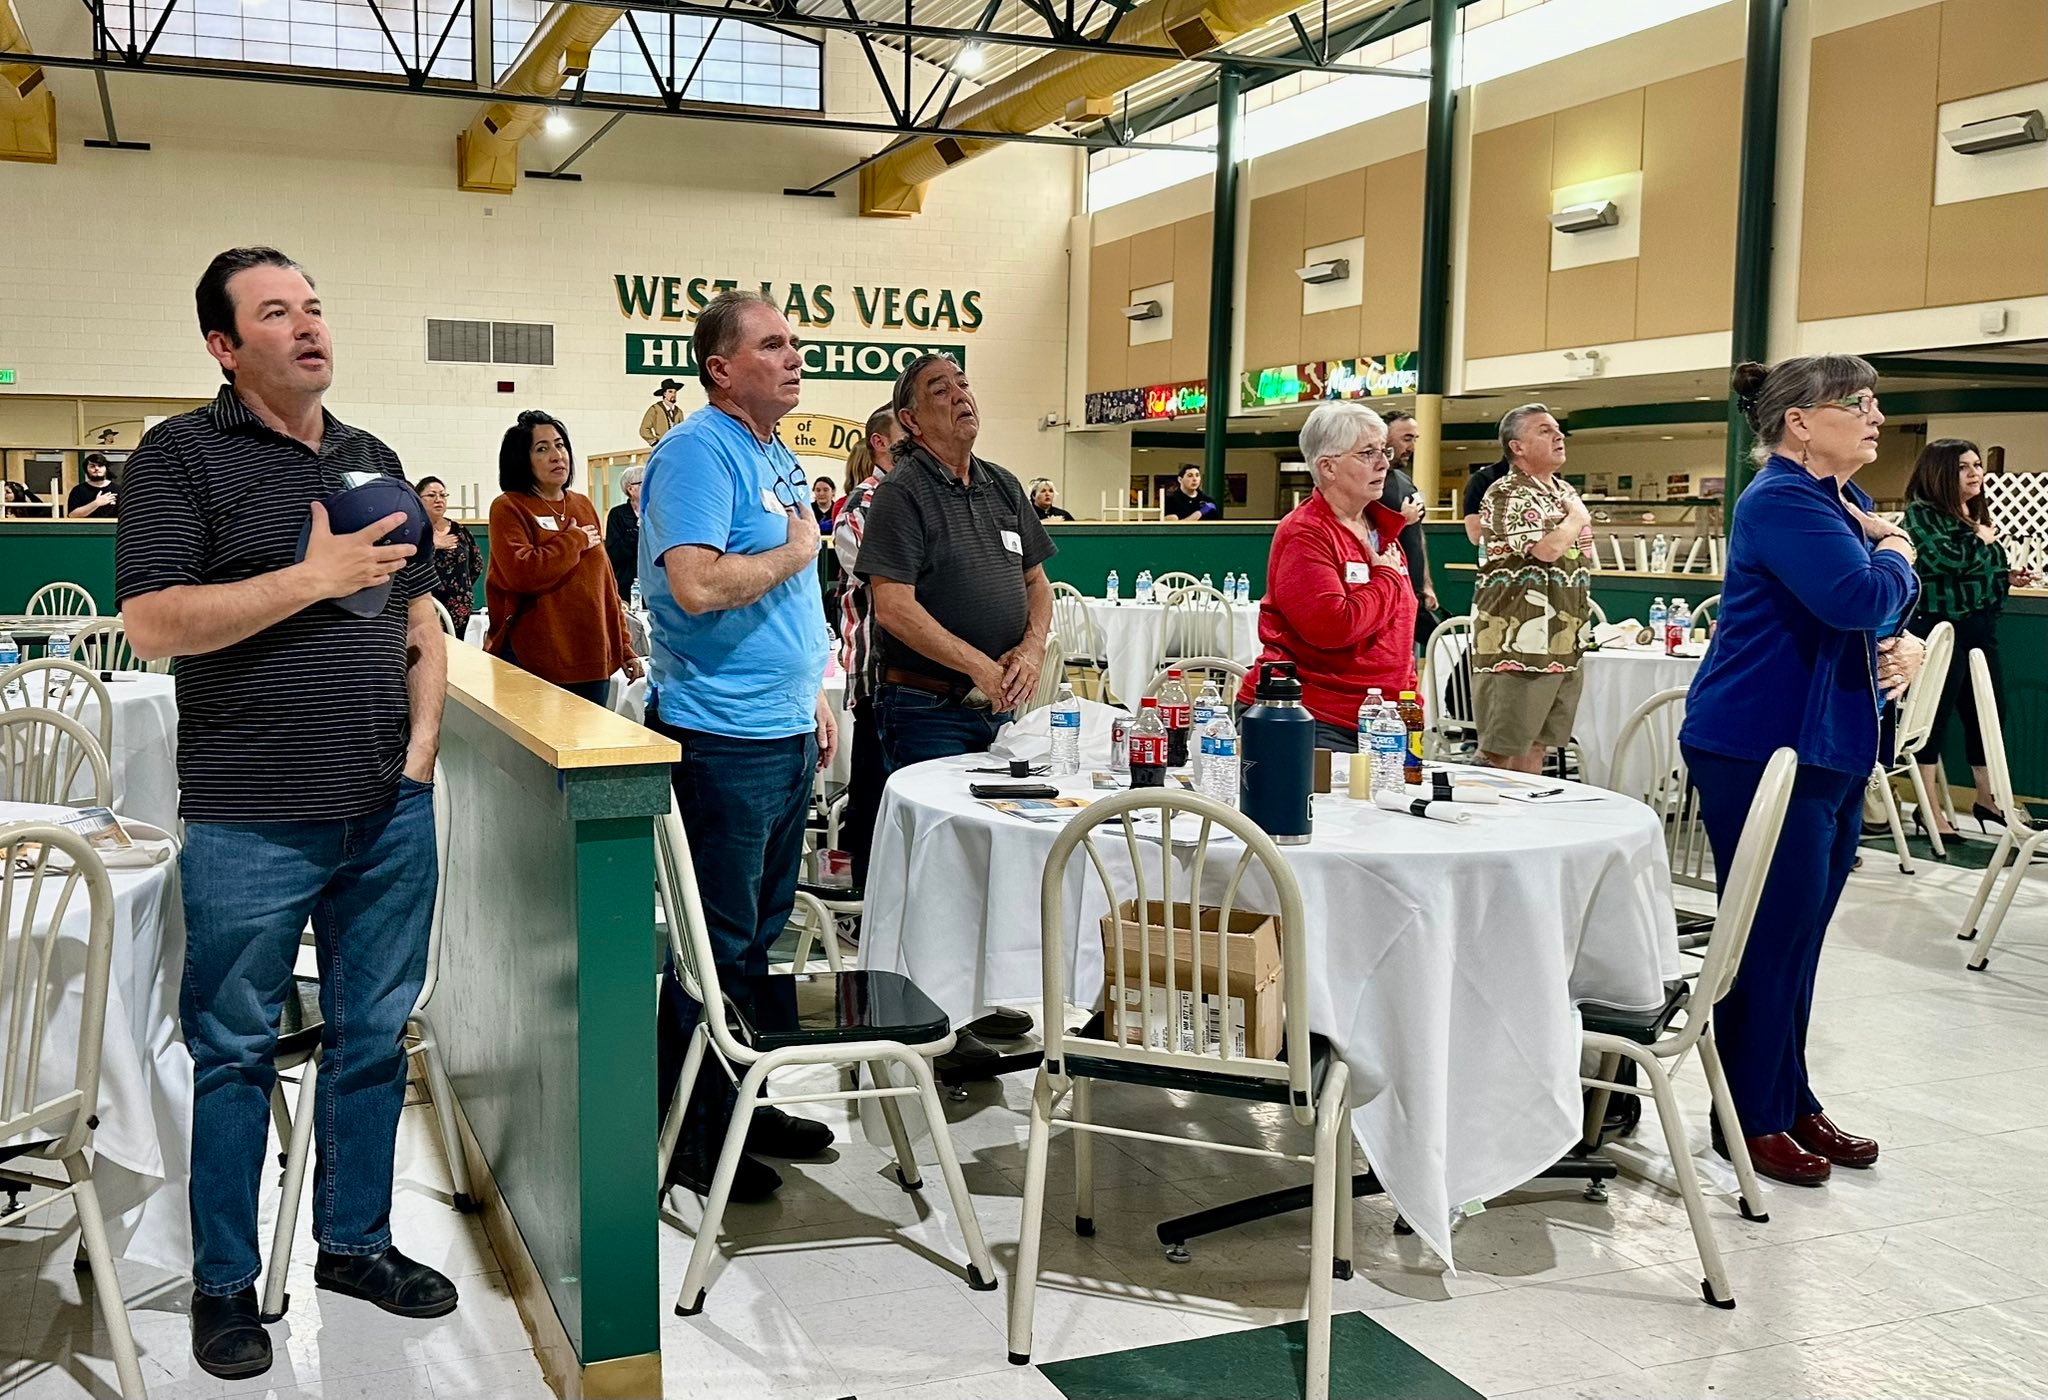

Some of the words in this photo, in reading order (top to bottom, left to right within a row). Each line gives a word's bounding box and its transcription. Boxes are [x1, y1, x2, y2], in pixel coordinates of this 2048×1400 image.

[852, 286, 984, 333] VEGAS
[799, 344, 942, 375] CHOO
[797, 420, 812, 432] of
[794, 433, 817, 446] the
